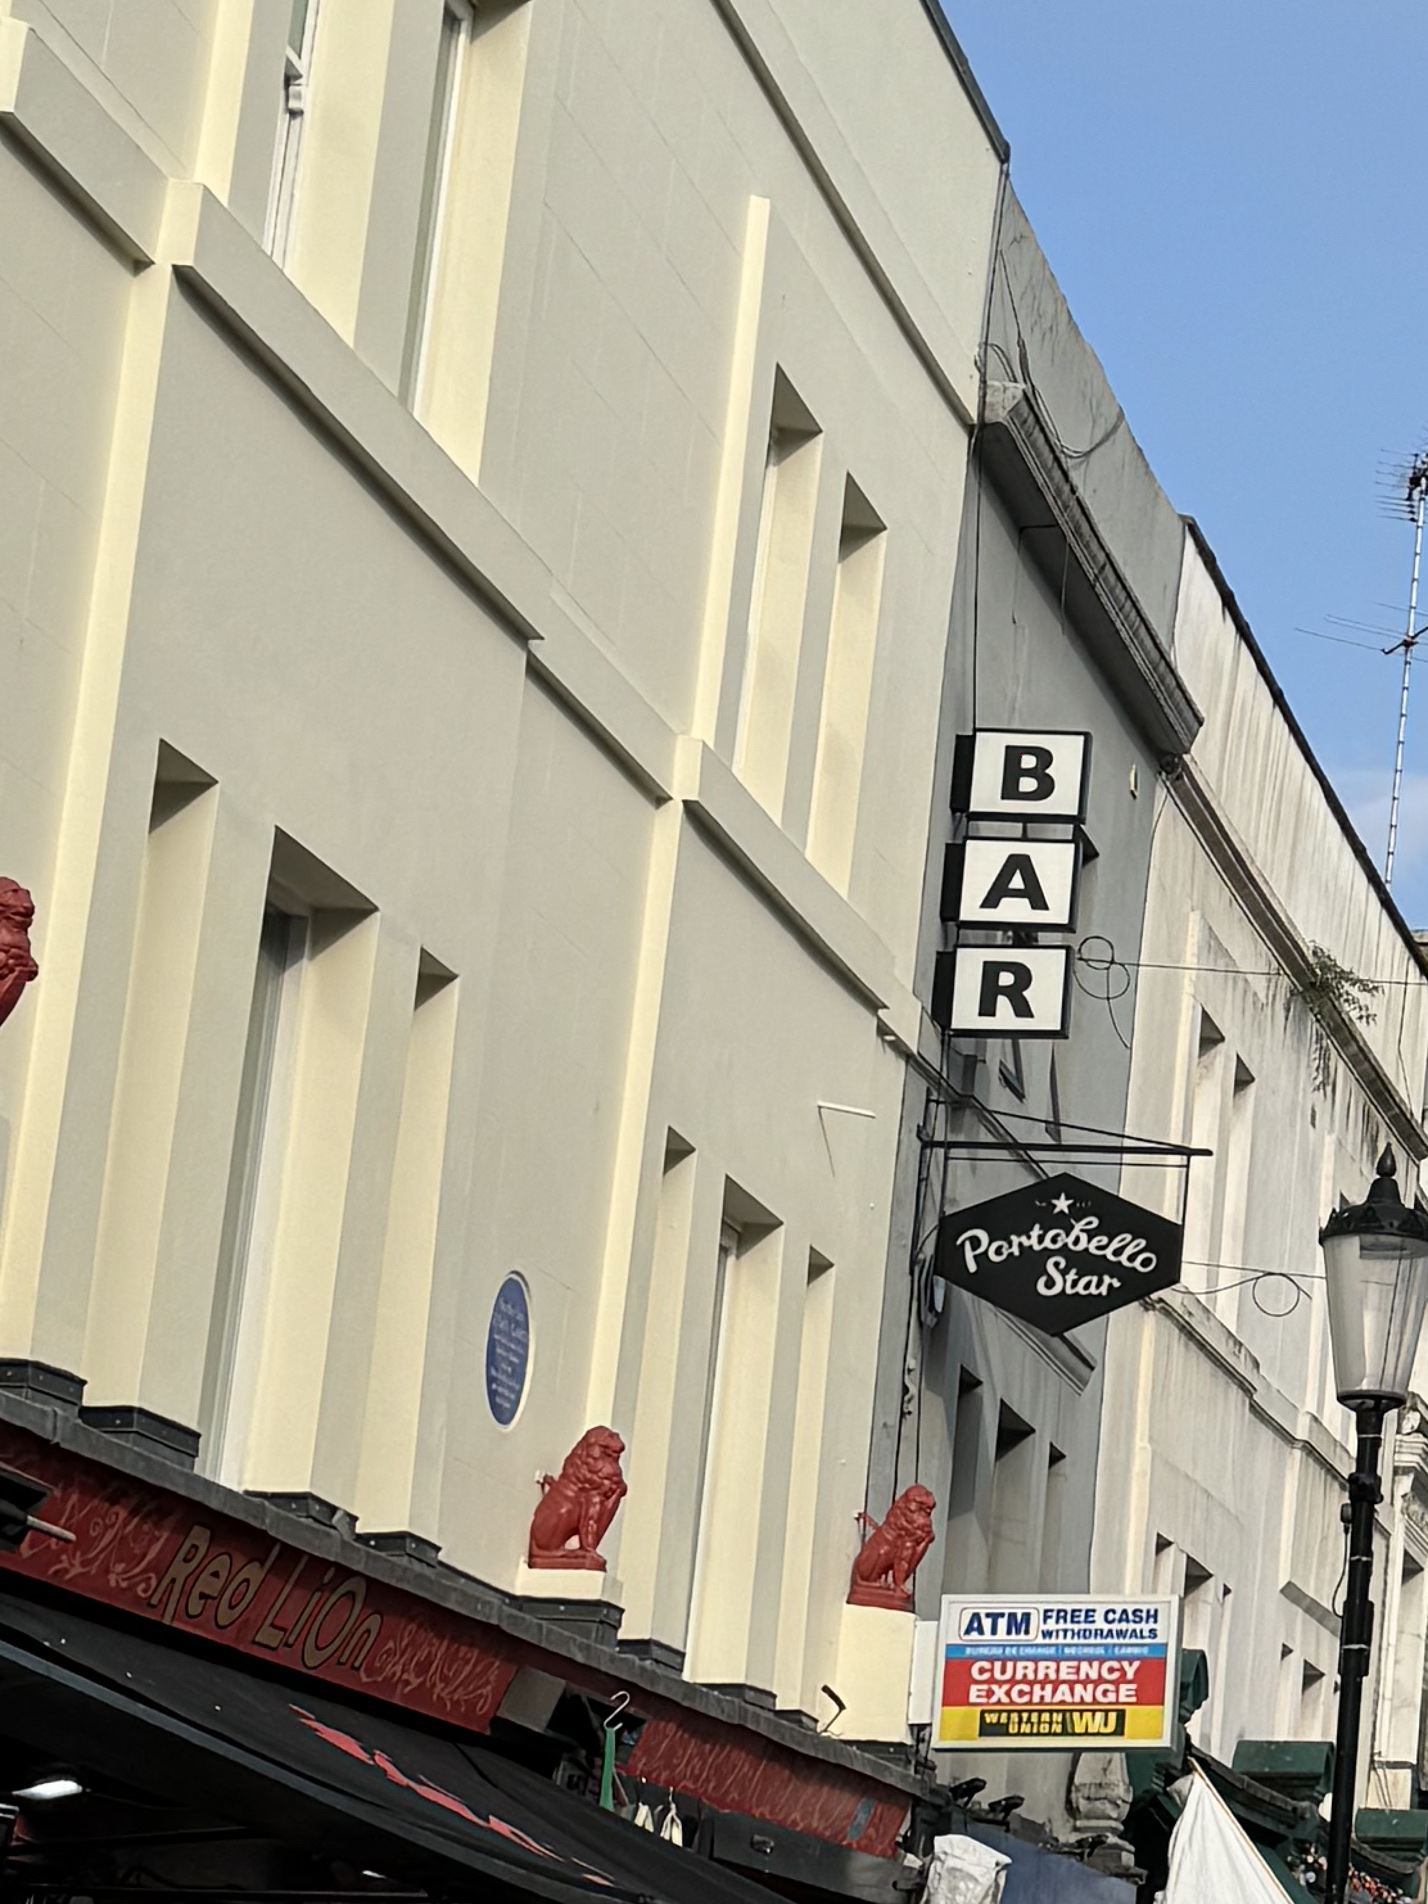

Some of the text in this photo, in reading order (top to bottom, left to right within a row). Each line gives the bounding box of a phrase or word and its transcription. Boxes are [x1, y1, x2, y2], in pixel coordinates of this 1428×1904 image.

[978, 744, 1056, 1019] BAR
[956, 1216, 1157, 1274] Portobello
[1036, 1256, 1121, 1296] Star
[150, 1522, 283, 1630] Red
[963, 1608, 1159, 1637] ATM FREE CASH
[1041, 1628, 1158, 1641] WITHDRAWALS
[970, 1660, 1141, 1681] CURRENCY
[968, 1683, 1138, 1704] EXCHANGE
